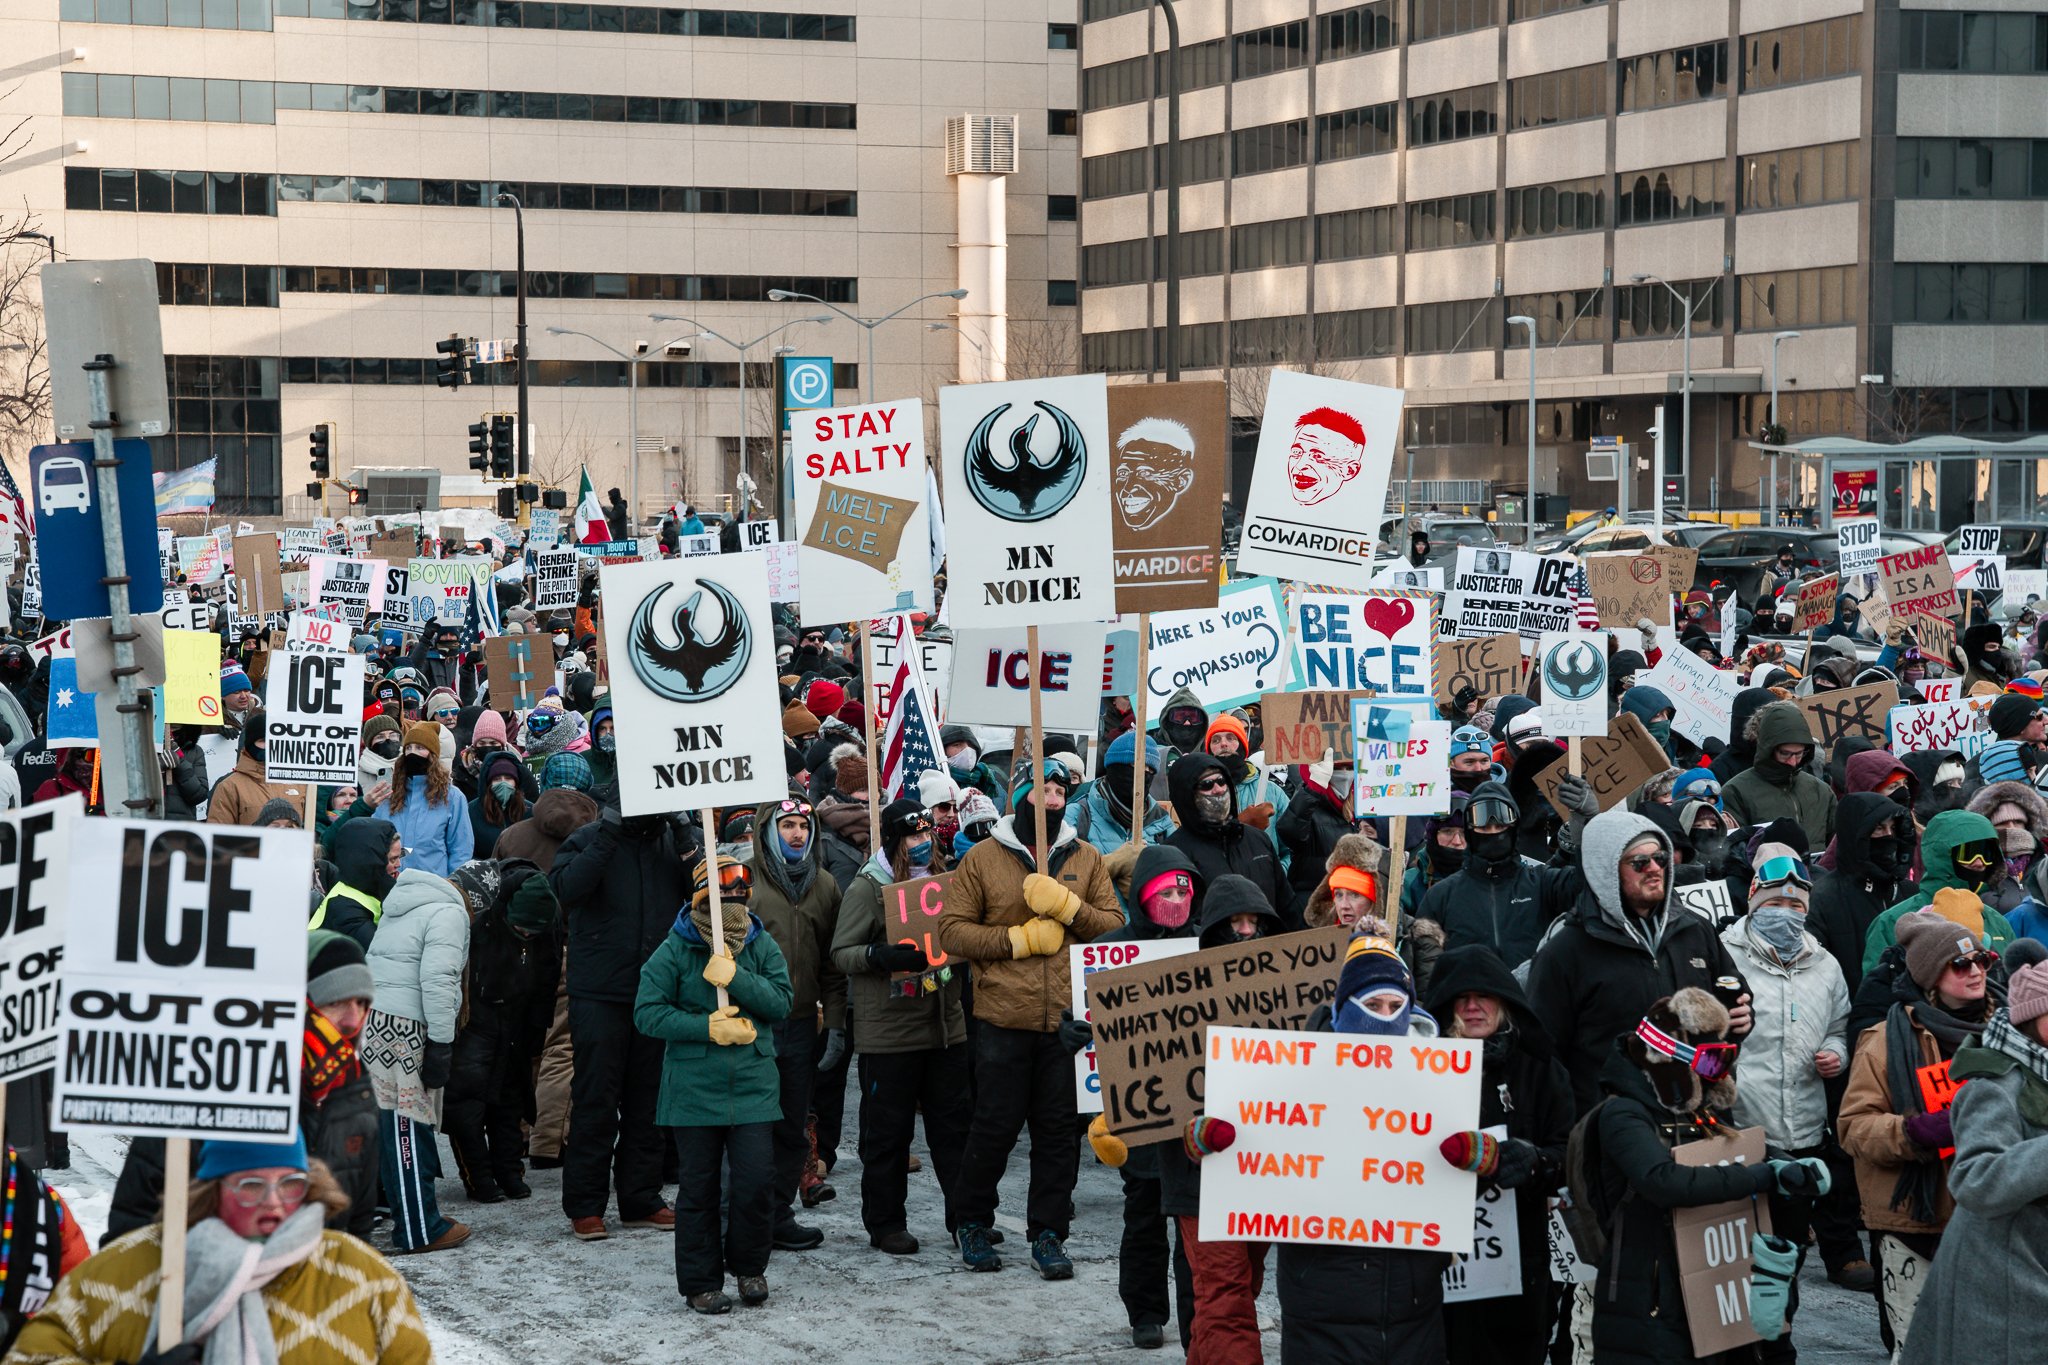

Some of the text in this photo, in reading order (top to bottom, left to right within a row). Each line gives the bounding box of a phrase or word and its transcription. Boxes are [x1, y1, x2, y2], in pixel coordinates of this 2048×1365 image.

[815, 408, 897, 442] STAY
[806, 442, 912, 479] SALTY
[532, 510, 558, 518] JUSTICE
[826, 490, 894, 525] MELT
[353, 524, 372, 532] WAKE
[748, 522, 771, 546] ICE
[820, 521, 881, 556] I.C.E.
[1247, 524, 1371, 557] COWARDICE
[1840, 523, 1877, 547] STOP
[1962, 529, 1998, 551] STOP
[540, 553, 577, 567] GENERAL
[1006, 545, 1054, 571] MN
[1114, 555, 1214, 577] WARDICE
[1842, 548, 1879, 561] ICE TERROR
[1876, 545, 1945, 577] TRUMP
[322, 579, 370, 594] JUSTICE FOR
[539, 565, 577, 580] STRIKE:
[539, 579, 577, 593] THE PATH TO
[1456, 574, 1523, 595] JUSTICE FOR
[1532, 557, 1574, 599] ICE
[1592, 563, 1618, 587] NO
[1893, 573, 1936, 596] IS A
[444, 587, 469, 597] YER
[538, 591, 577, 606] JUSTICE
[983, 576, 1081, 606] NOICE
[1809, 579, 1831, 600] STOP
[1890, 589, 1957, 618] TERRORIST
[384, 600, 397, 612] ICE
[1199, 619, 1215, 634] IS
[1221, 605, 1267, 629] YOUR
[1594, 596, 1620, 617] NO
[307, 621, 332, 641] NO
[1300, 603, 1352, 643] BE
[1488, 612, 1519, 630] GOOD
[986, 648, 1073, 692] ICE
[1306, 645, 1425, 695] NICE
[1452, 638, 1499, 676] ICE
[1667, 647, 1704, 682] Human
[287, 654, 345, 714] ICE
[1925, 684, 1952, 703] ICE
[1300, 693, 1350, 723] MN
[1547, 703, 1585, 717] ICE
[269, 722, 359, 740] OUT OF
[674, 724, 723, 752] MN
[1554, 719, 1590, 733] OUT
[22, 751, 57, 765] FedEx
[268, 739, 356, 767] MINNESOTA
[1369, 739, 1429, 761] VALUES
[652, 755, 754, 790] NOICE
[1377, 763, 1402, 777] OUR
[1362, 783, 1436, 799] DIVERSITY
[115, 828, 262, 971] ICE
[1083, 944, 1140, 966] STOP
[1096, 985, 1140, 1010] WE
[1143, 966, 1214, 999] WISH
[1223, 951, 1280, 982] FOR
[1282, 942, 1337, 970] YOU
[69, 990, 203, 1025] OUT
[213, 998, 297, 1030] OF
[1097, 979, 1338, 1043] WHAT YOU WISH FOR
[64, 1029, 291, 1096] MINNESOTA
[1211, 1035, 1472, 1075] I WANT FOR YOU
[1109, 1075, 1171, 1124] ICE
[63, 1100, 289, 1131] PARTY FOR SOCIALISM & LIBERATION
[1239, 1101, 1432, 1136] WHAT YOU
[1237, 1151, 1425, 1186] WANT FOR
[1227, 1212, 1441, 1247] IMMIGRANTS
[1703, 1217, 1749, 1268] OUT
